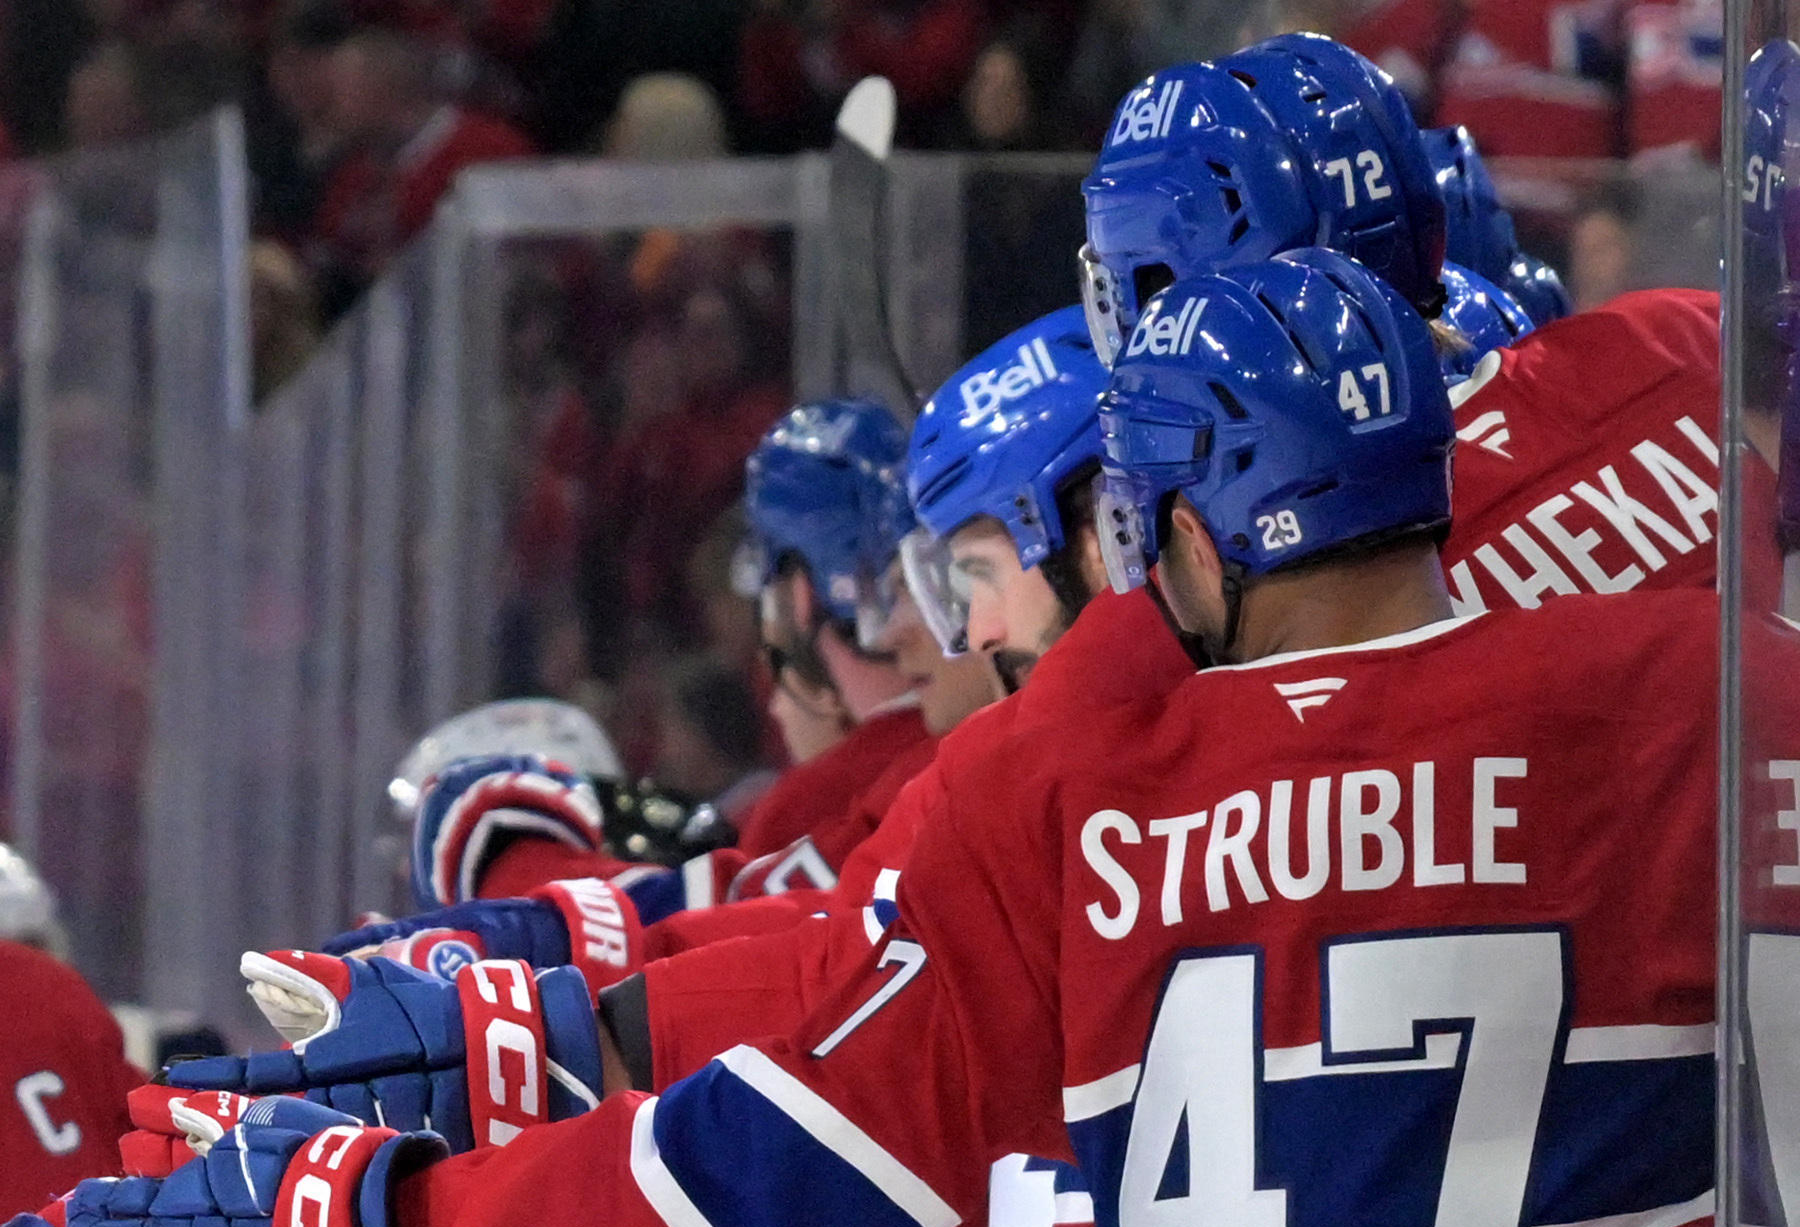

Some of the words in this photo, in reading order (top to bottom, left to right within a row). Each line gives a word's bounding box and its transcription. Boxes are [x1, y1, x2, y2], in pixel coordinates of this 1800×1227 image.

[1111, 80, 1183, 146] Bell
[1326, 150, 1392, 208] 72
[1126, 297, 1208, 357] Bell
[959, 337, 1059, 428] Bell
[1338, 362, 1391, 420] 47
[1256, 510, 1302, 551] 29
[1450, 415, 1720, 618] HEKA
[1080, 757, 1528, 940] STRUBLE
[15, 1070, 81, 1154] C
